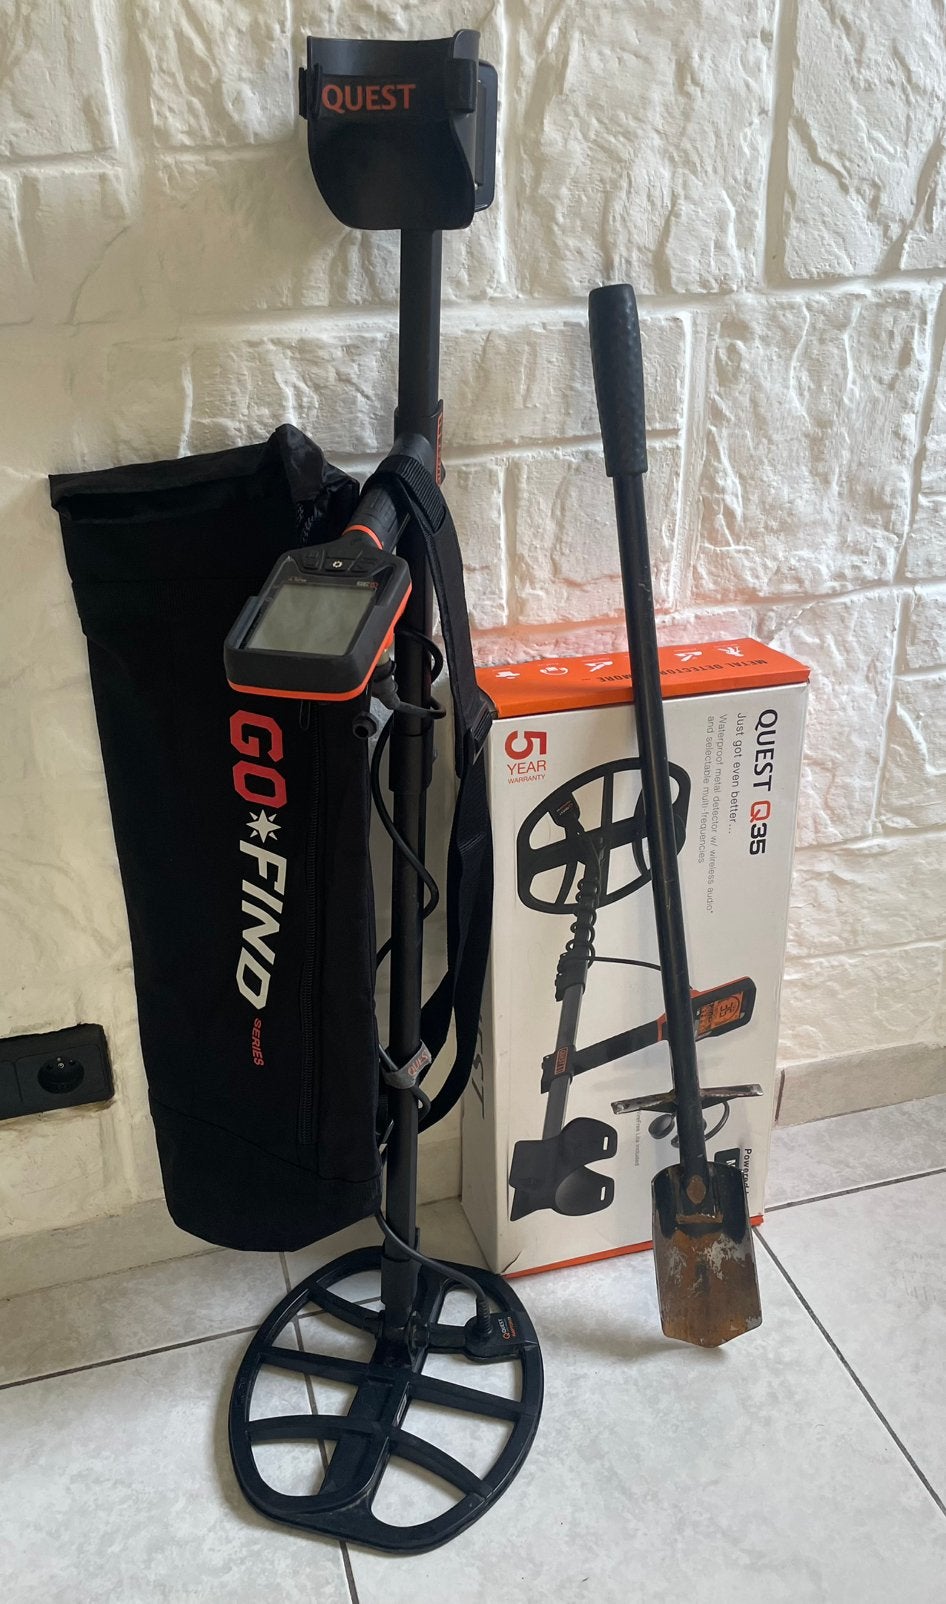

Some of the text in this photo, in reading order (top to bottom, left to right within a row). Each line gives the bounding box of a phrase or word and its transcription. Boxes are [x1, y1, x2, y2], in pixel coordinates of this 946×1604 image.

[321, 84, 416, 113] QUEST
[724, 659, 768, 668] METAL
[505, 730, 547, 760] 5
[715, 714, 727, 765] Waterproof
[507, 760, 546, 775] YEAR
[508, 774, 545, 784] WARRANTY
[713, 768, 723, 793] metal
[728, 713, 746, 834] Just got even better...
[749, 709, 778, 854] QUEST Q35
[697, 716, 715, 864] and selectable multi-frequencies
[711, 796, 721, 832] detector
[229, 709, 287, 1010] GO FIND
[708, 850, 716, 884] wireless
[252, 1018, 264, 1066] SERIES
